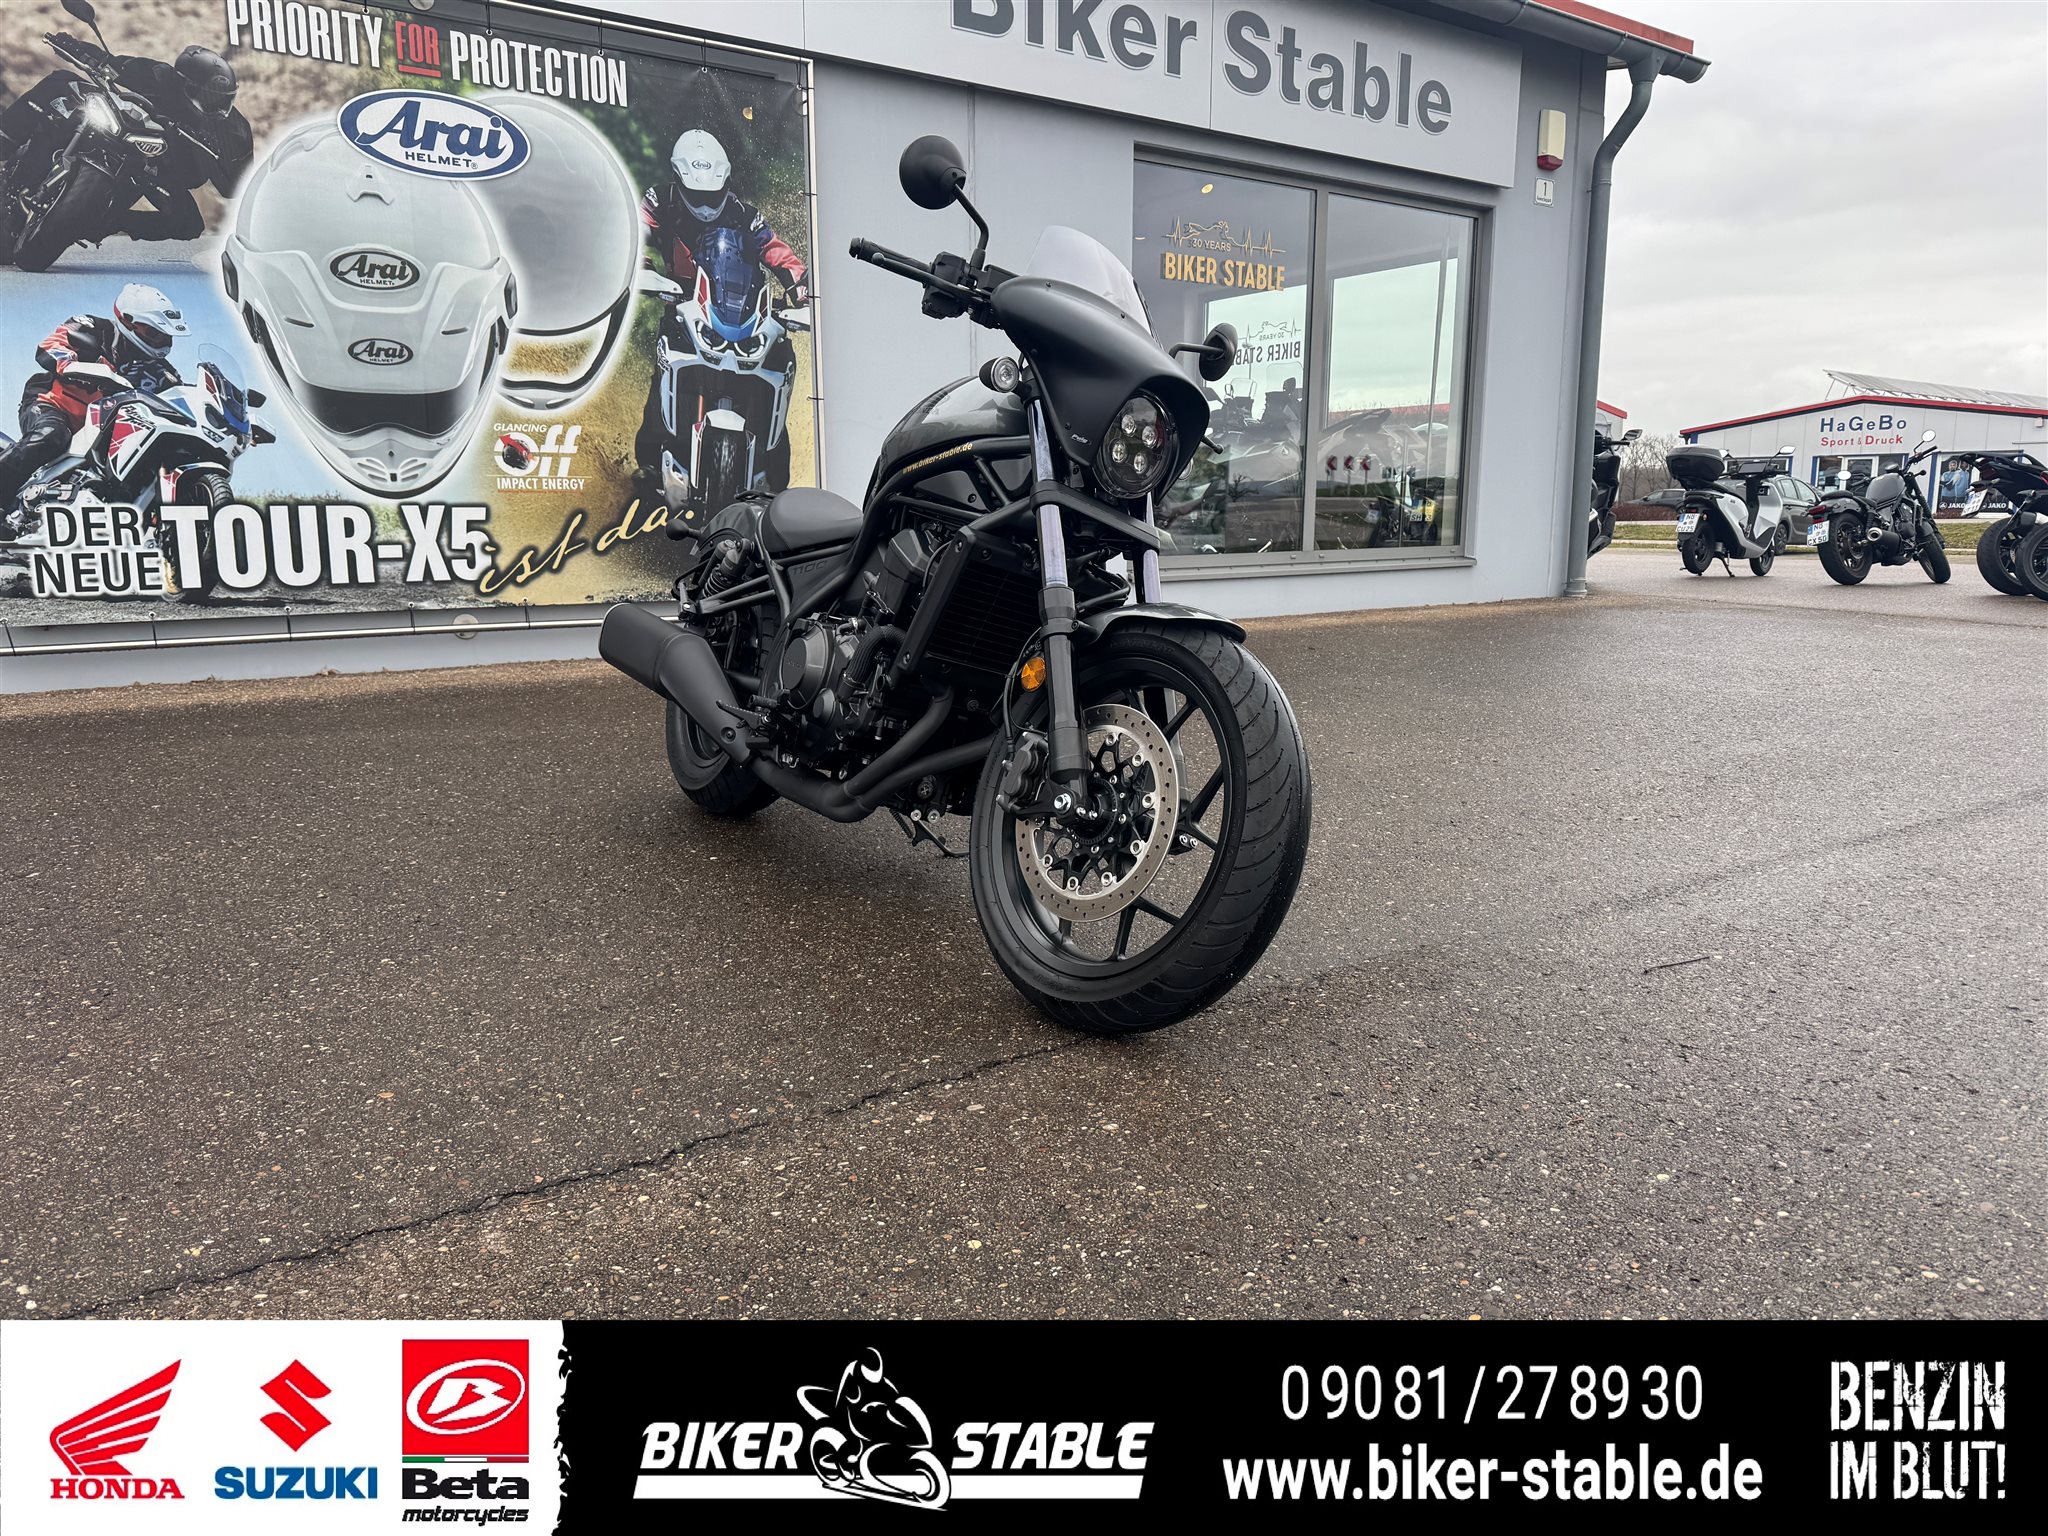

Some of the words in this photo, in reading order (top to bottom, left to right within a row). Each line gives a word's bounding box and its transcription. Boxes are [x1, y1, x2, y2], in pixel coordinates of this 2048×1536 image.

[226, 0, 382, 68] PRIORITY
[395, 20, 441, 66] FOR
[449, 30, 629, 107] PROTECTION
[1224, 10, 1453, 134] Stable
[355, 100, 507, 159] Arai
[1192, 238, 1203, 248] 30
[1205, 240, 1231, 252] YEARS
[337, 255, 410, 281] Arai
[1165, 252, 1217, 284] BIKER
[1224, 260, 1285, 291] STABLE
[353, 341, 406, 359] Arai
[493, 422, 548, 432] GLANCING
[1820, 415, 1907, 432] HaGeBo
[1821, 437, 1854, 447] Sport
[1865, 435, 1903, 445] Druck
[496, 478, 538, 489] IMPACT
[542, 479, 585, 490] ENERGY
[45, 507, 141, 547] DER
[160, 504, 491, 589] TOUR-X5
[33, 552, 163, 594] NEUE
[479, 513, 585, 594] ist
